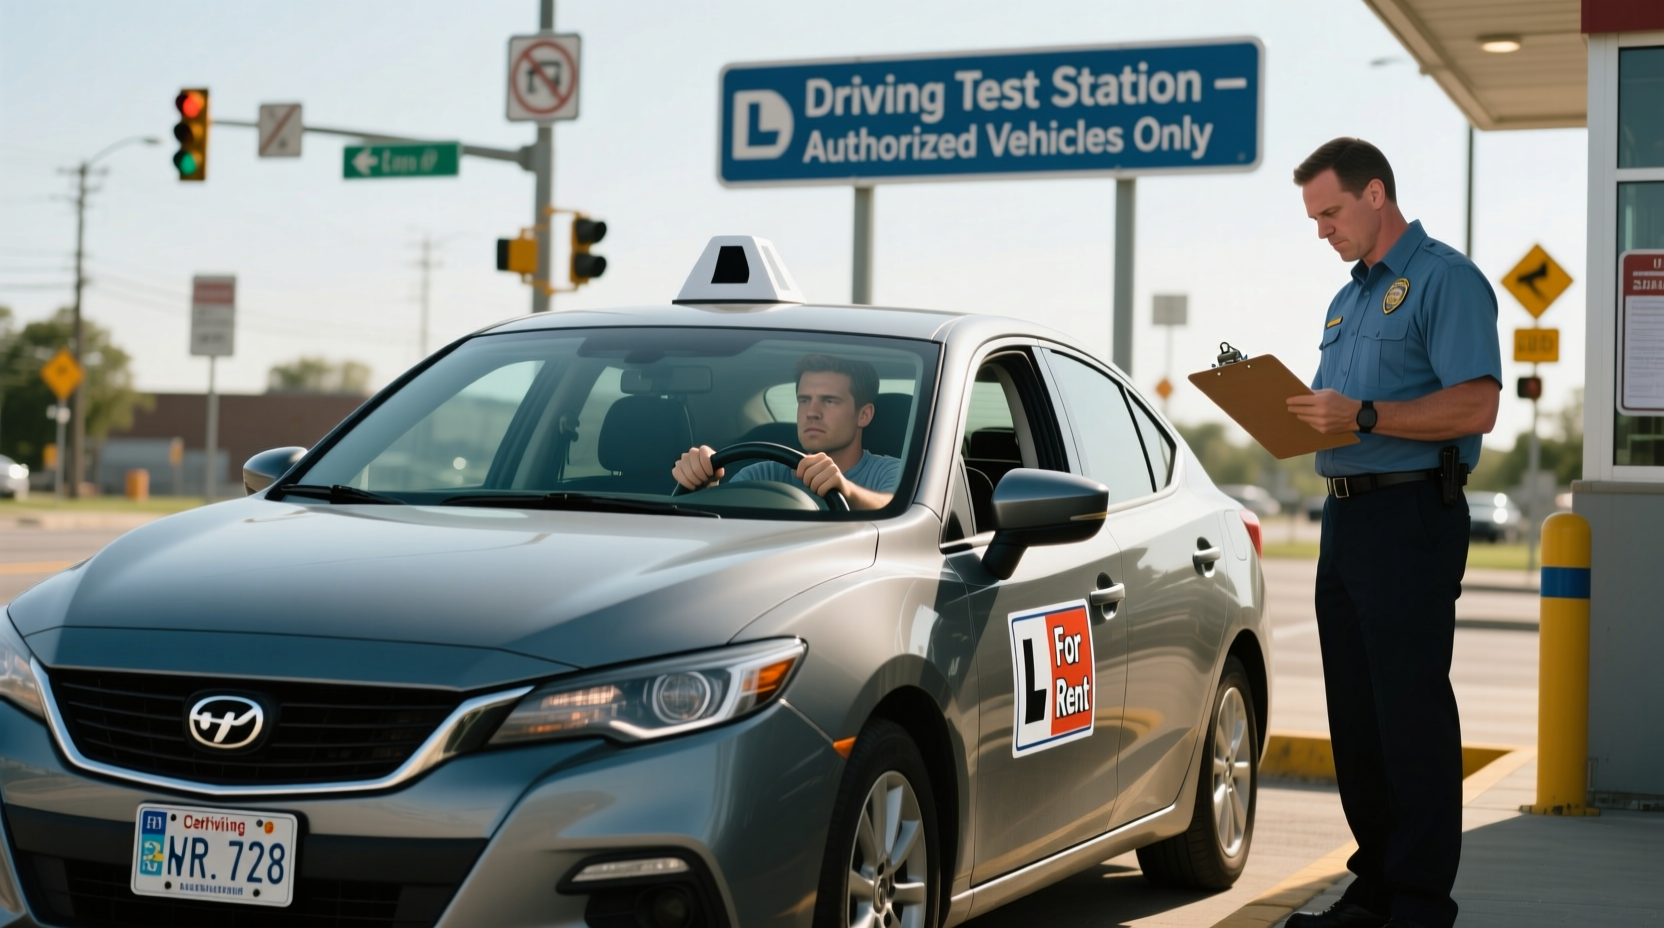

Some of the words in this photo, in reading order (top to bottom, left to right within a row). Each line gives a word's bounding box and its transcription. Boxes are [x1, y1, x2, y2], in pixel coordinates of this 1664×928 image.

[805, 73, 945, 124] Driving
[954, 70, 1040, 111] Test
[1051, 61, 1202, 108] Station
[802, 124, 977, 164] Authorized
[986, 119, 1124, 157] Vehicles
[1133, 115, 1213, 160] Only
[1053, 625, 1081, 667] For
[1022, 638, 1047, 725] L
[1055, 675, 1090, 720] Rent
[229, 840, 286, 885] 728
